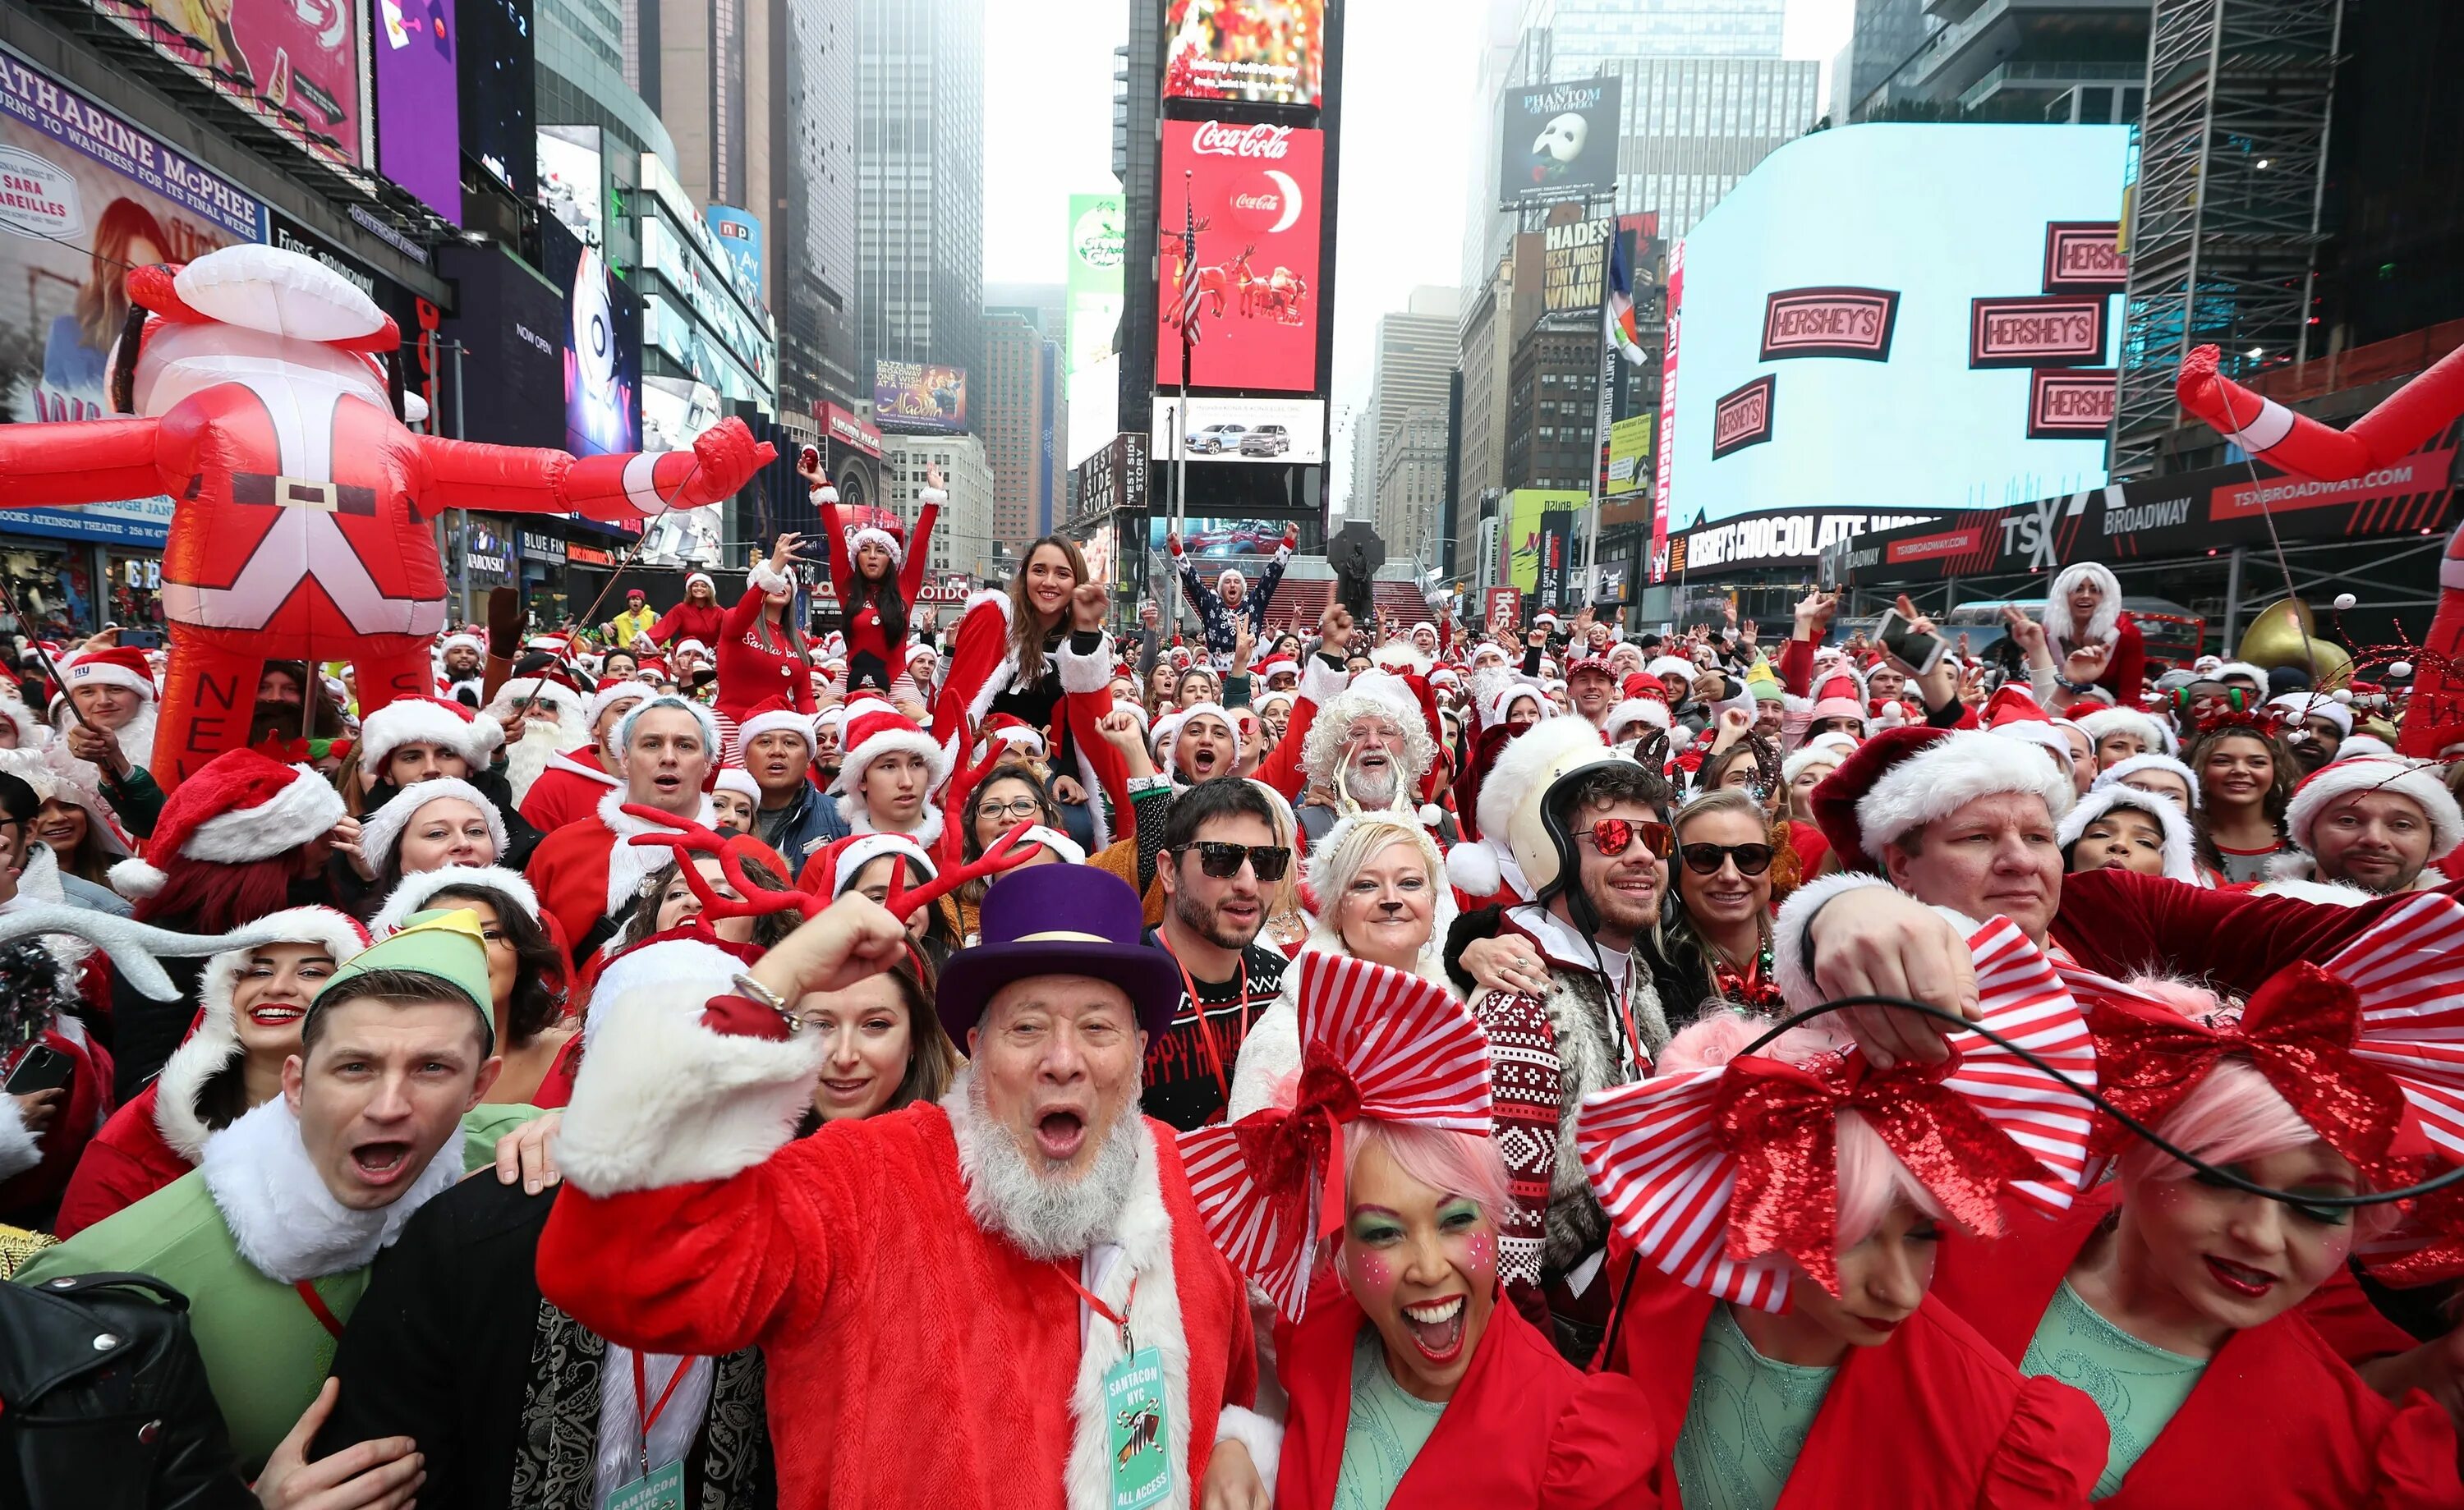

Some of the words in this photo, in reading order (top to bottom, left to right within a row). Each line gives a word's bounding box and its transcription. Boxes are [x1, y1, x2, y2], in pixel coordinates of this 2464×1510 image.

[1524, 87, 1601, 108] PHANTOM
[1563, 100, 1593, 111] OPERA
[3, 174, 44, 196] SARA
[41, 114, 62, 135] TO
[67, 126, 135, 175] WAITRESS
[138, 168, 163, 190] FOR
[166, 181, 185, 200] ITS
[187, 194, 221, 222] FINAL
[223, 214, 257, 241] WEEKS
[1545, 249, 1571, 269] BEST
[1545, 266, 1576, 287] TONY
[1775, 307, 1878, 337] HERSHEY'S
[1988, 314, 2090, 346] HERSHEY'S
[516, 323, 534, 345] NOW
[534, 335, 553, 356] OPEN
[876, 360, 922, 371] DAZZLING
[876, 367, 922, 377] BROADWAY
[899, 375, 922, 383] WISH
[876, 392, 943, 418] Aladdin
[1662, 369, 1676, 414] FREE
[1719, 398, 1762, 439] HERSHEY'S
[1086, 445, 1113, 478] WEST
[1127, 436, 1135, 466] SIDE
[1087, 466, 1111, 498] SIDE
[1136, 448, 1144, 492] STORY
[1657, 415, 1673, 519] CHOCOLATE
[1083, 485, 1115, 514] STORY
[1126, 469, 1135, 504] WEST
[0, 510, 30, 523] OOKS
[31, 514, 81, 530] ATKINSON
[82, 520, 123, 534] THEATRE
[2103, 497, 2192, 535] BROADWAY
[524, 531, 548, 551] BLUE
[550, 538, 566, 554] FIN
[1736, 514, 1866, 561] CHOCOLATE
[1896, 536, 1969, 556] TSXBROADWAY.COM
[2000, 496, 2058, 569] TSX
[916, 585, 984, 600] OTDO
[1142, 1028, 1190, 1086] PPY
[1110, 1366, 1157, 1397] SANTACON
[1127, 1388, 1145, 1407] NYC
[1117, 1491, 1133, 1507] ALL
[1135, 1472, 1167, 1500] ACCESS
